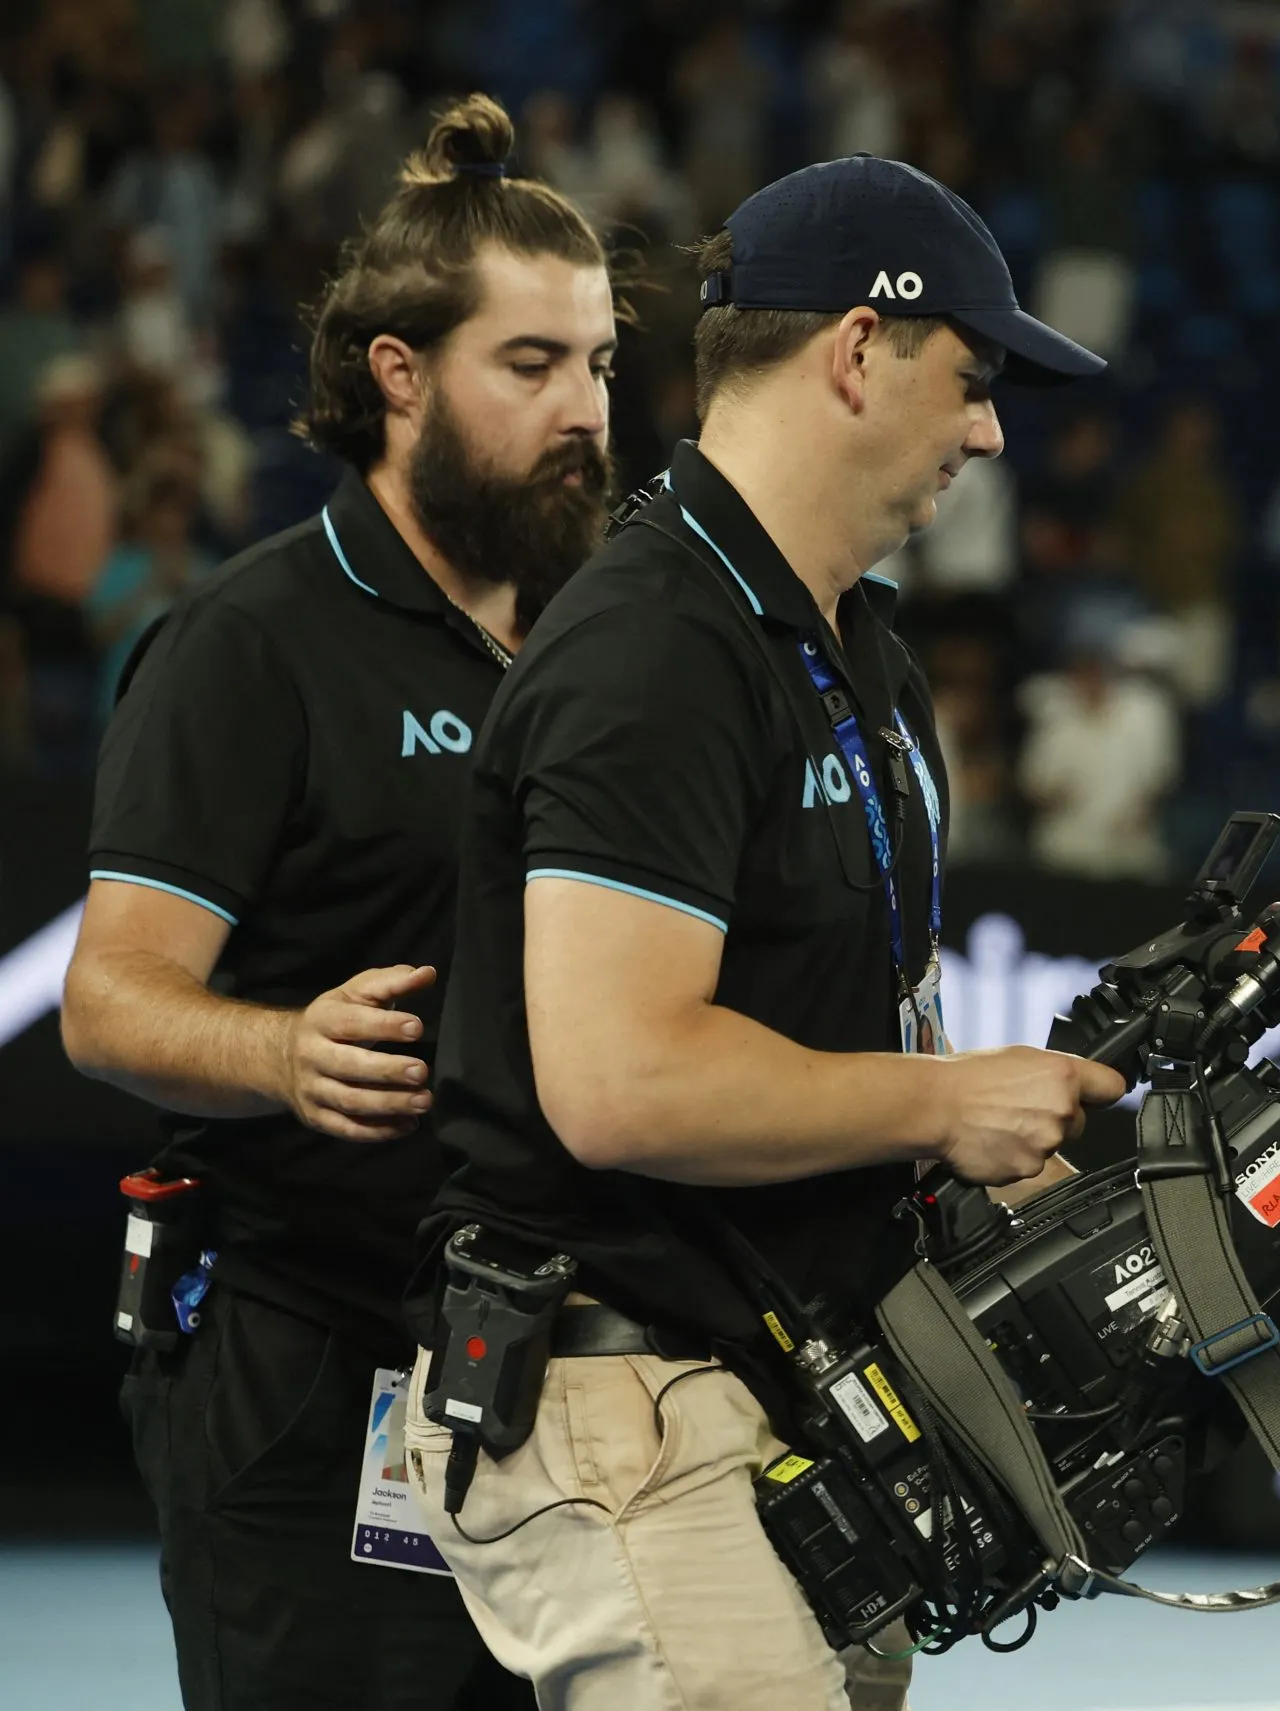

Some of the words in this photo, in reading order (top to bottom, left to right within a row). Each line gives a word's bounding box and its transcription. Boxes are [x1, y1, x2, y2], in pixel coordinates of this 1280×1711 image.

[867, 270, 924, 301] AO
[401, 709, 472, 757] AO
[802, 753, 852, 808] AO
[854, 753, 871, 788] AO
[1234, 1140, 1279, 1186] SONY
[1097, 1320, 1119, 1340] LIVE
